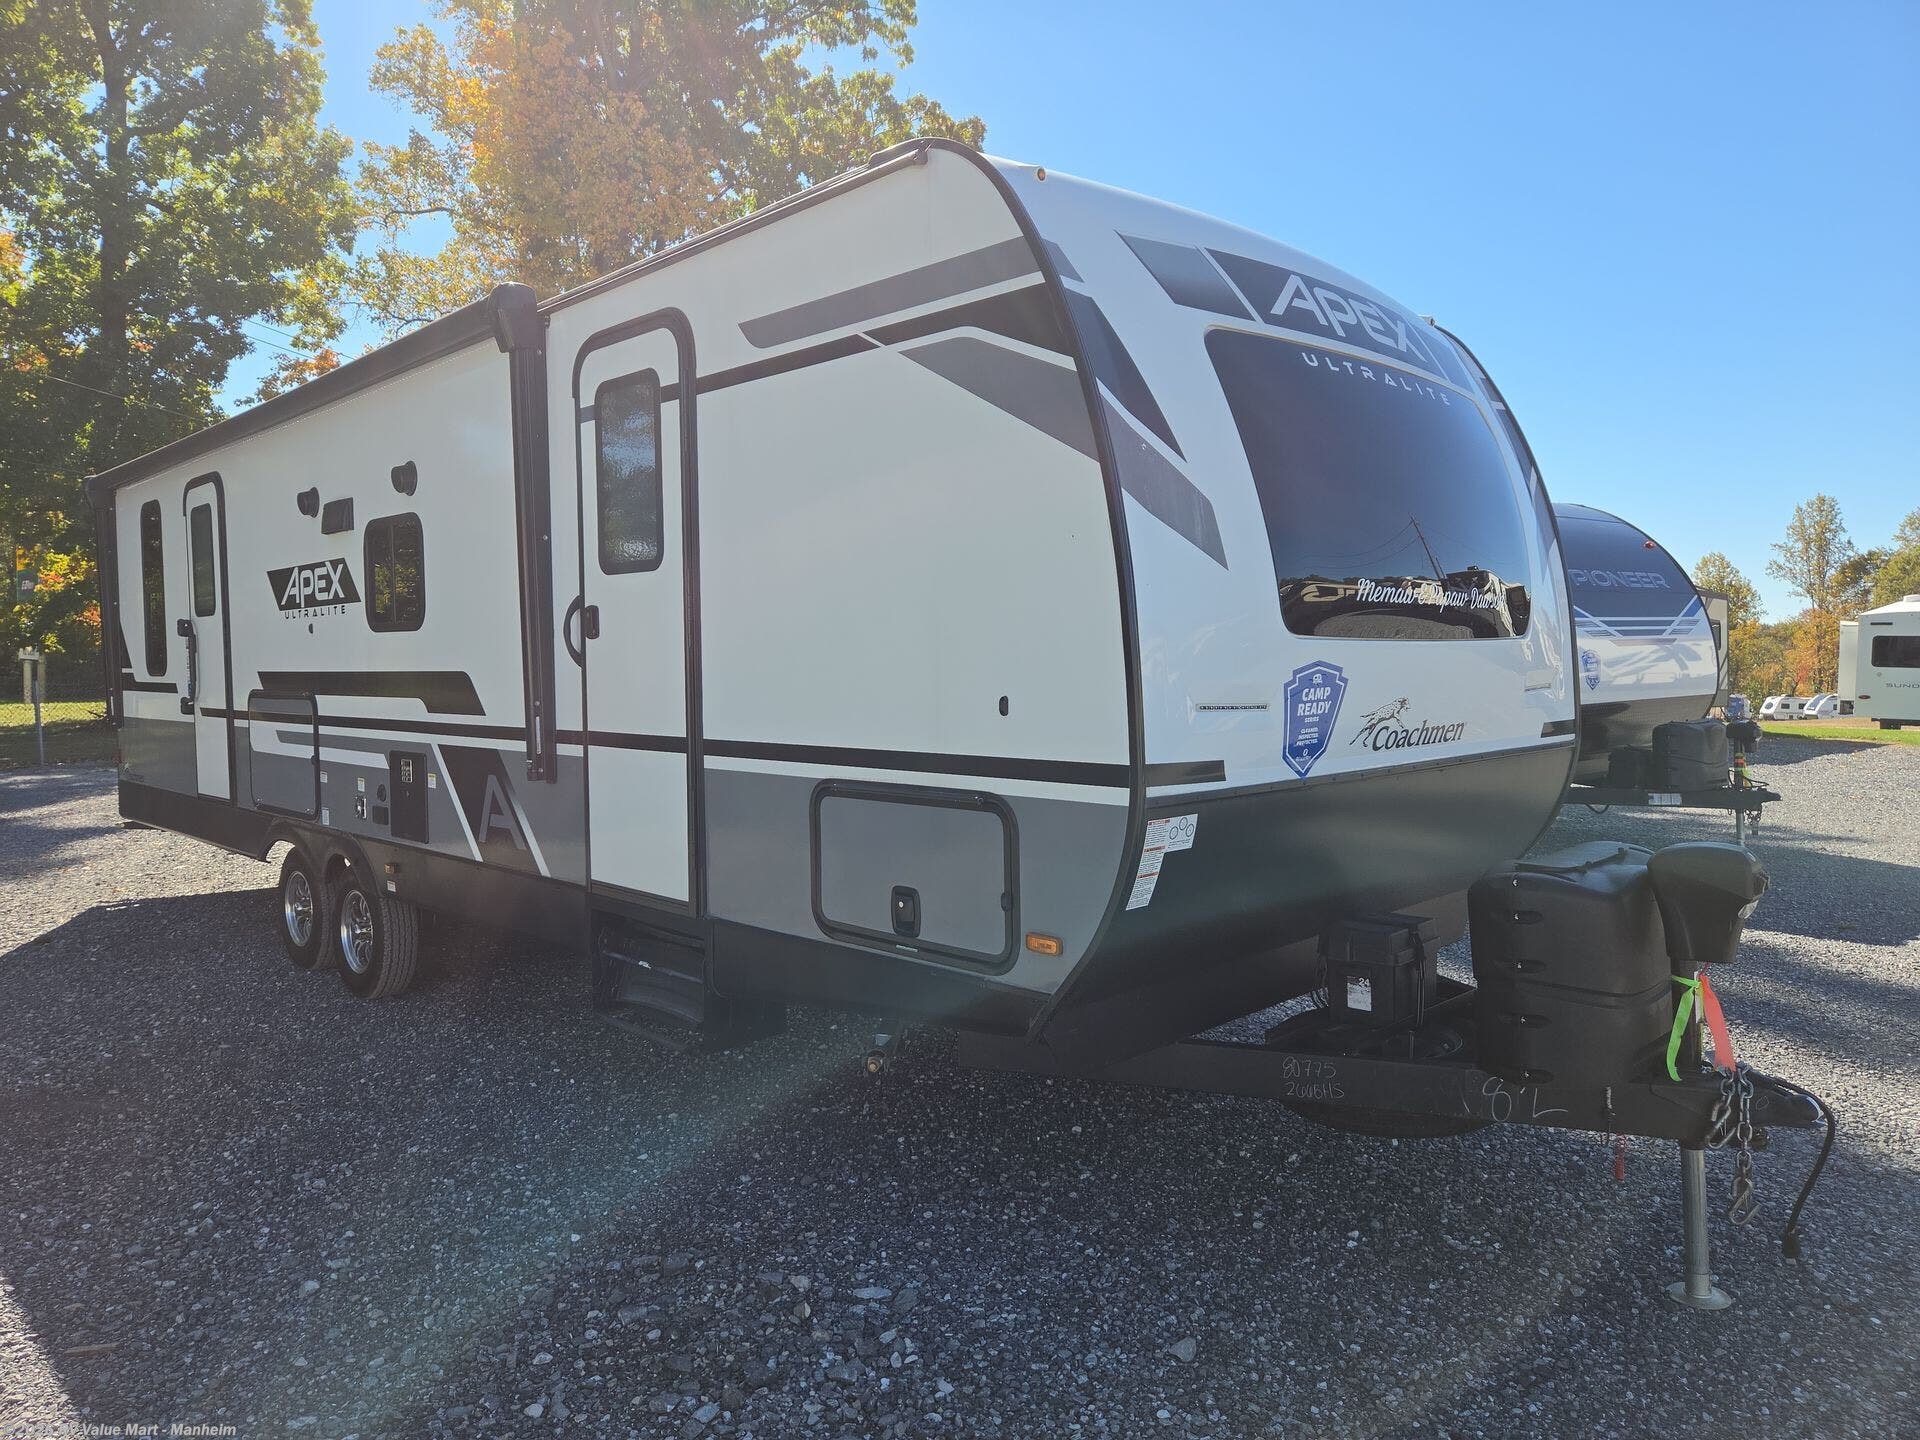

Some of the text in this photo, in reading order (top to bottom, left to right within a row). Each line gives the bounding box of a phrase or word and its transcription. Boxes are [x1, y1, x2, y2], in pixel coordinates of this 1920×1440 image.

[1269, 274, 1428, 364] APEX
[1301, 351, 1451, 407] ULTRALITE
[280, 561, 345, 608] APEX
[1567, 569, 1671, 588] PIONEER
[1356, 578, 1415, 603] Memaw
[1431, 582, 1469, 613] Papaw
[285, 606, 345, 619] ULTRALITE
[1297, 701, 1331, 716] READY
[1302, 686, 1331, 701] CAMP
[1372, 719, 1465, 751] Coachmen
